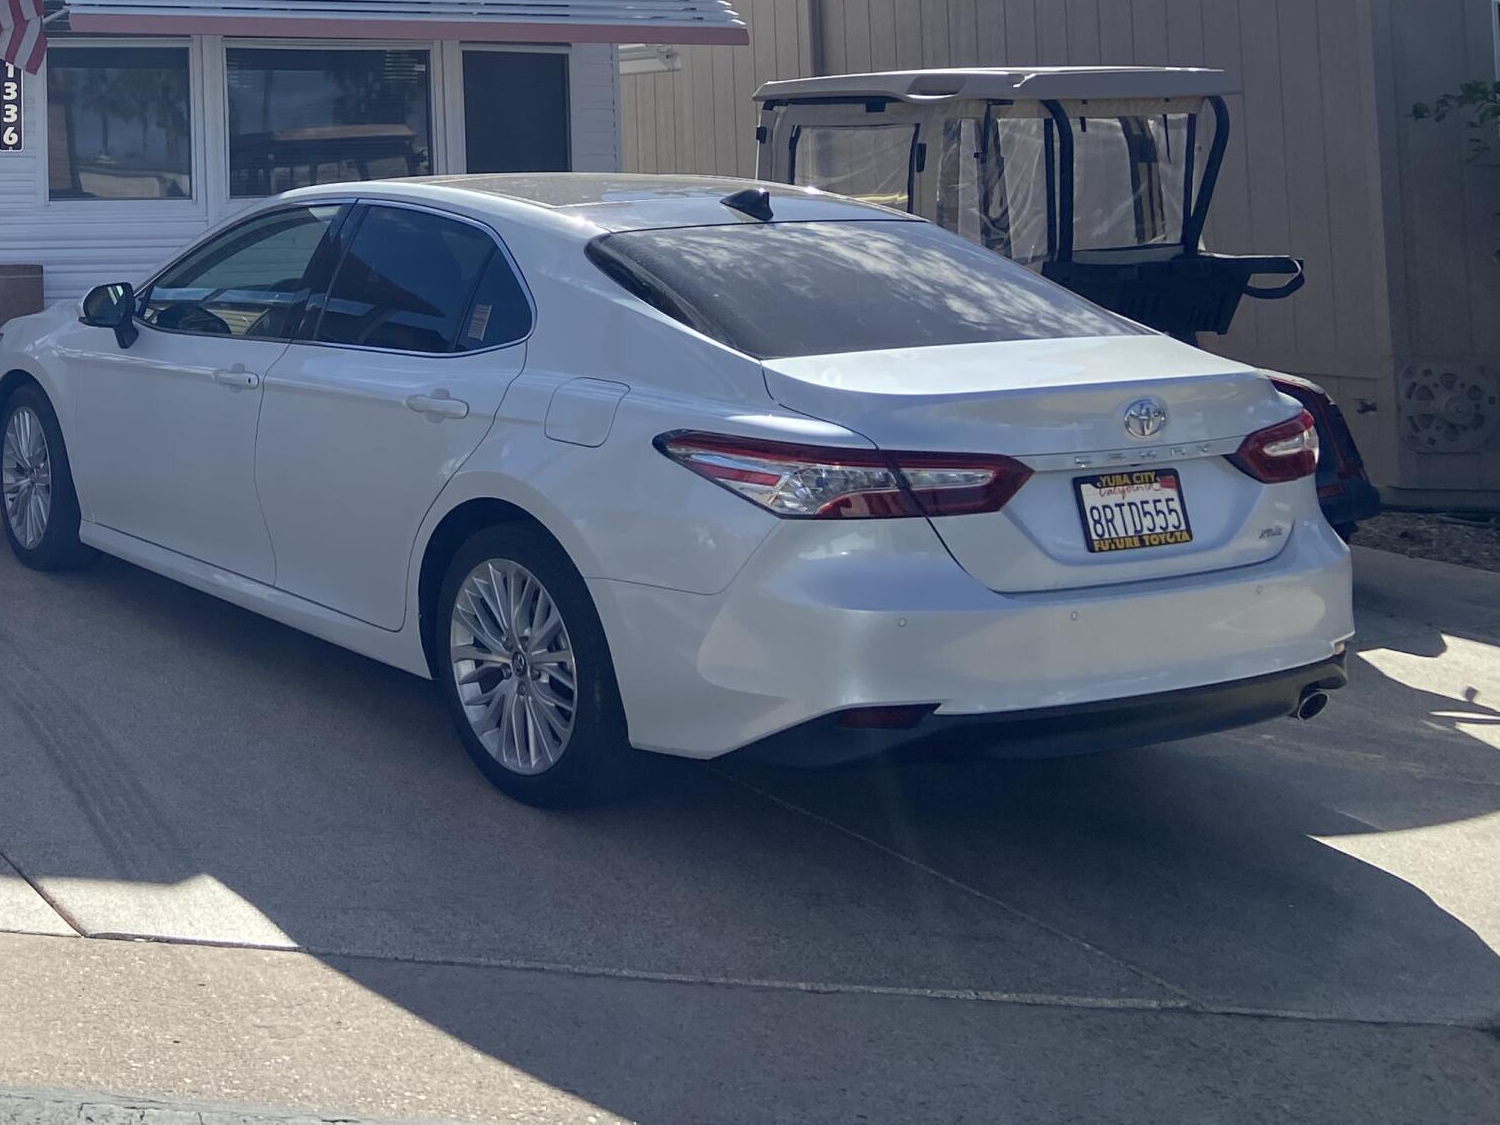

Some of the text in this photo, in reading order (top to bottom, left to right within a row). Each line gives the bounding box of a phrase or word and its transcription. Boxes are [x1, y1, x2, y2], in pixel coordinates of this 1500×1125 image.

[3, 61, 19, 145] 1336
[1100, 471, 1157, 487] YUBA CITY
[1089, 497, 1182, 538] 8RTD555
